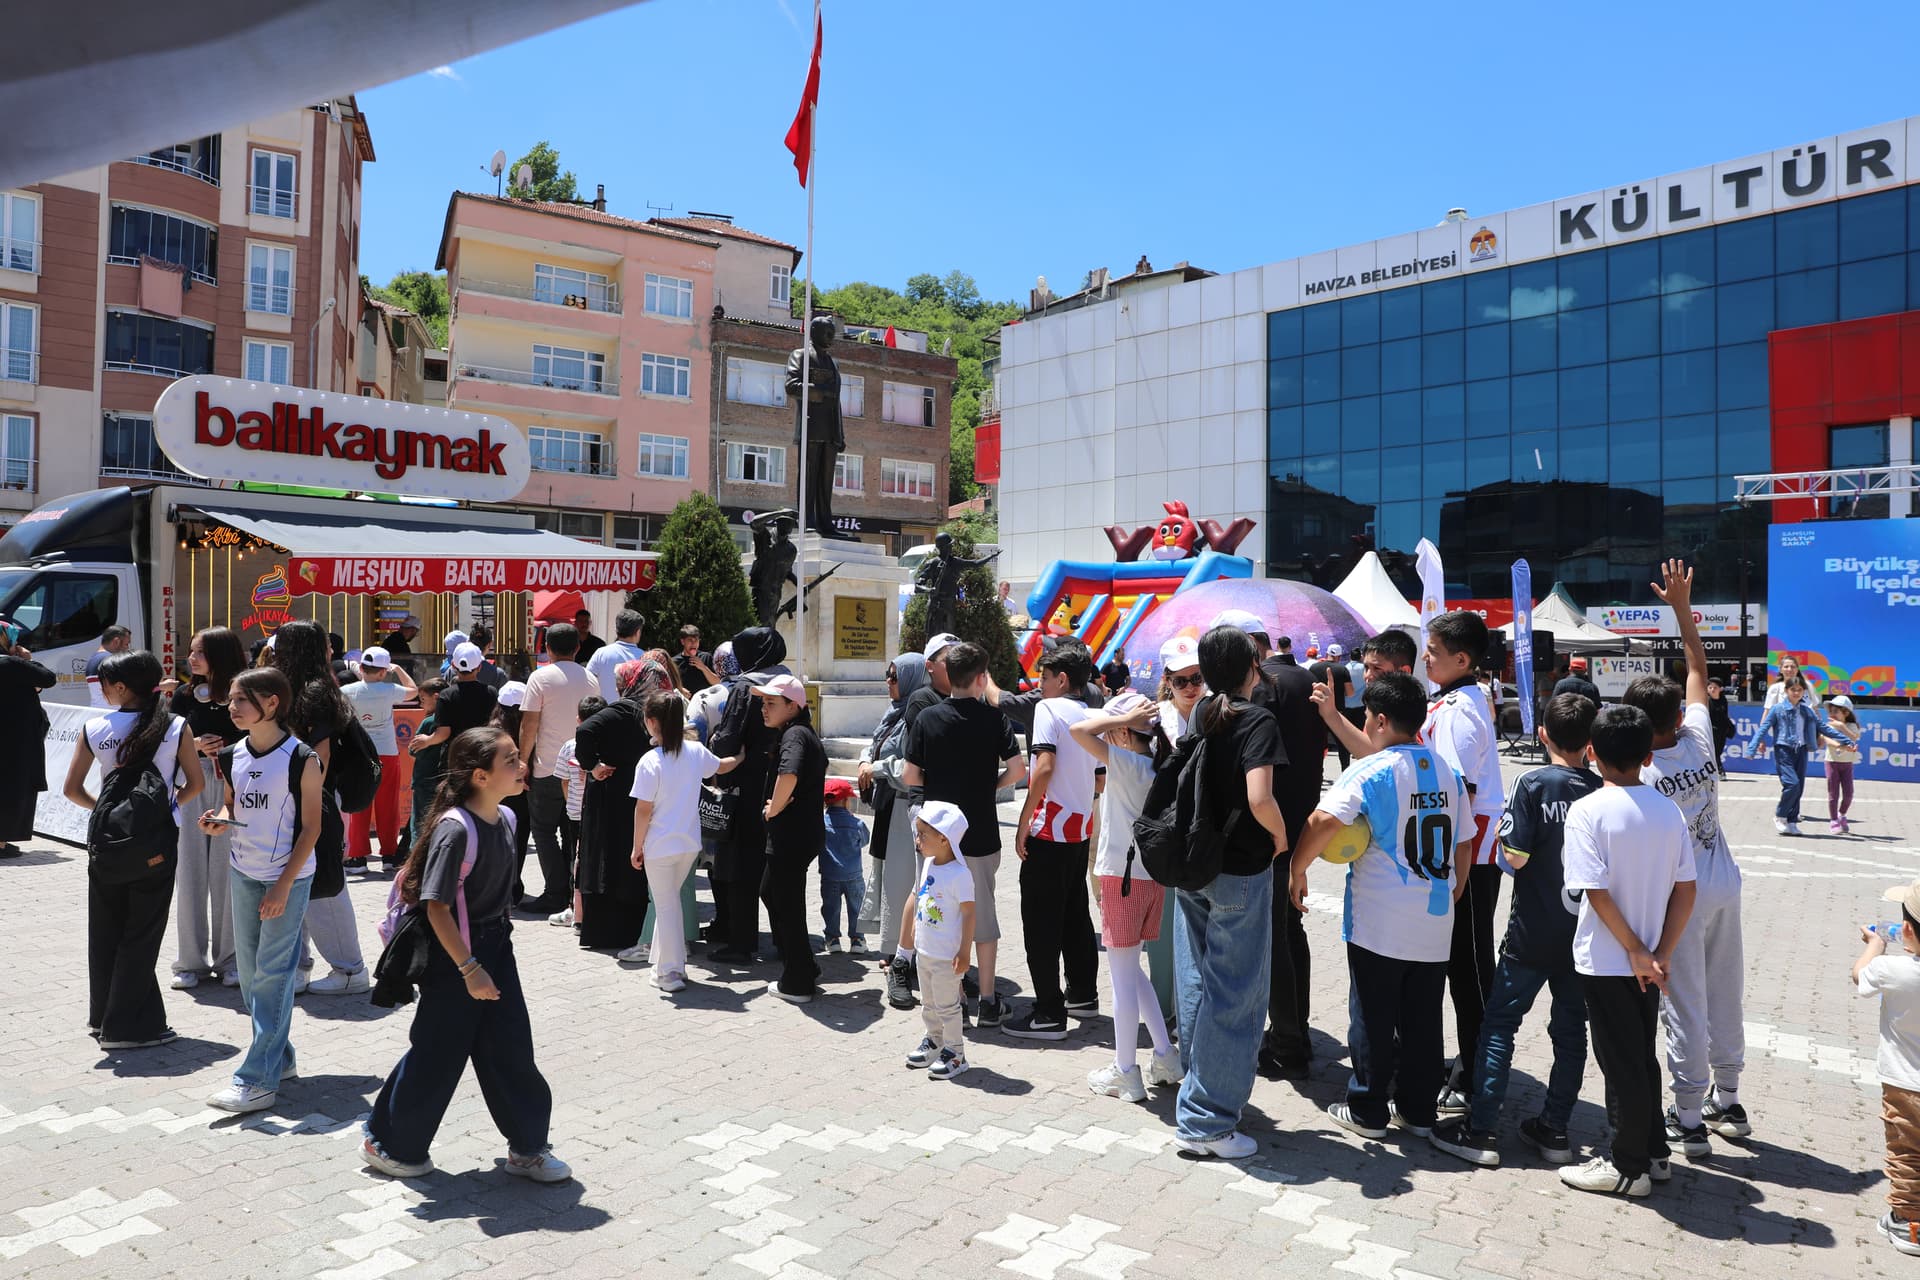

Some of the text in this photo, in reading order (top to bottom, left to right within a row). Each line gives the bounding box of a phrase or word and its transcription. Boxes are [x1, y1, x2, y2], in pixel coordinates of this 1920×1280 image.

[1559, 138, 1894, 245] KÜLTÜR
[1305, 250, 1457, 296] HAVZA BELEDİYESİ
[194, 390, 507, 481] ballıkaymak
[832, 517, 862, 531] tik
[333, 559, 637, 590] MEŞHUR BAFRA DONDURMASI
[1824, 556, 1920, 575] Büyükş
[1856, 572, 1920, 594] İlçele
[1887, 592, 1920, 607] Pa
[1617, 609, 1660, 623] YEPAŞ
[1704, 614, 1729, 623] kolay
[1652, 639, 1670, 650] ürk
[1611, 660, 1651, 675] YEPAŞ
[1869, 746, 1920, 768] Par
[239, 789, 269, 810] GSİM
[1409, 791, 1449, 810] MESSI
[1404, 813, 1453, 881] 10
